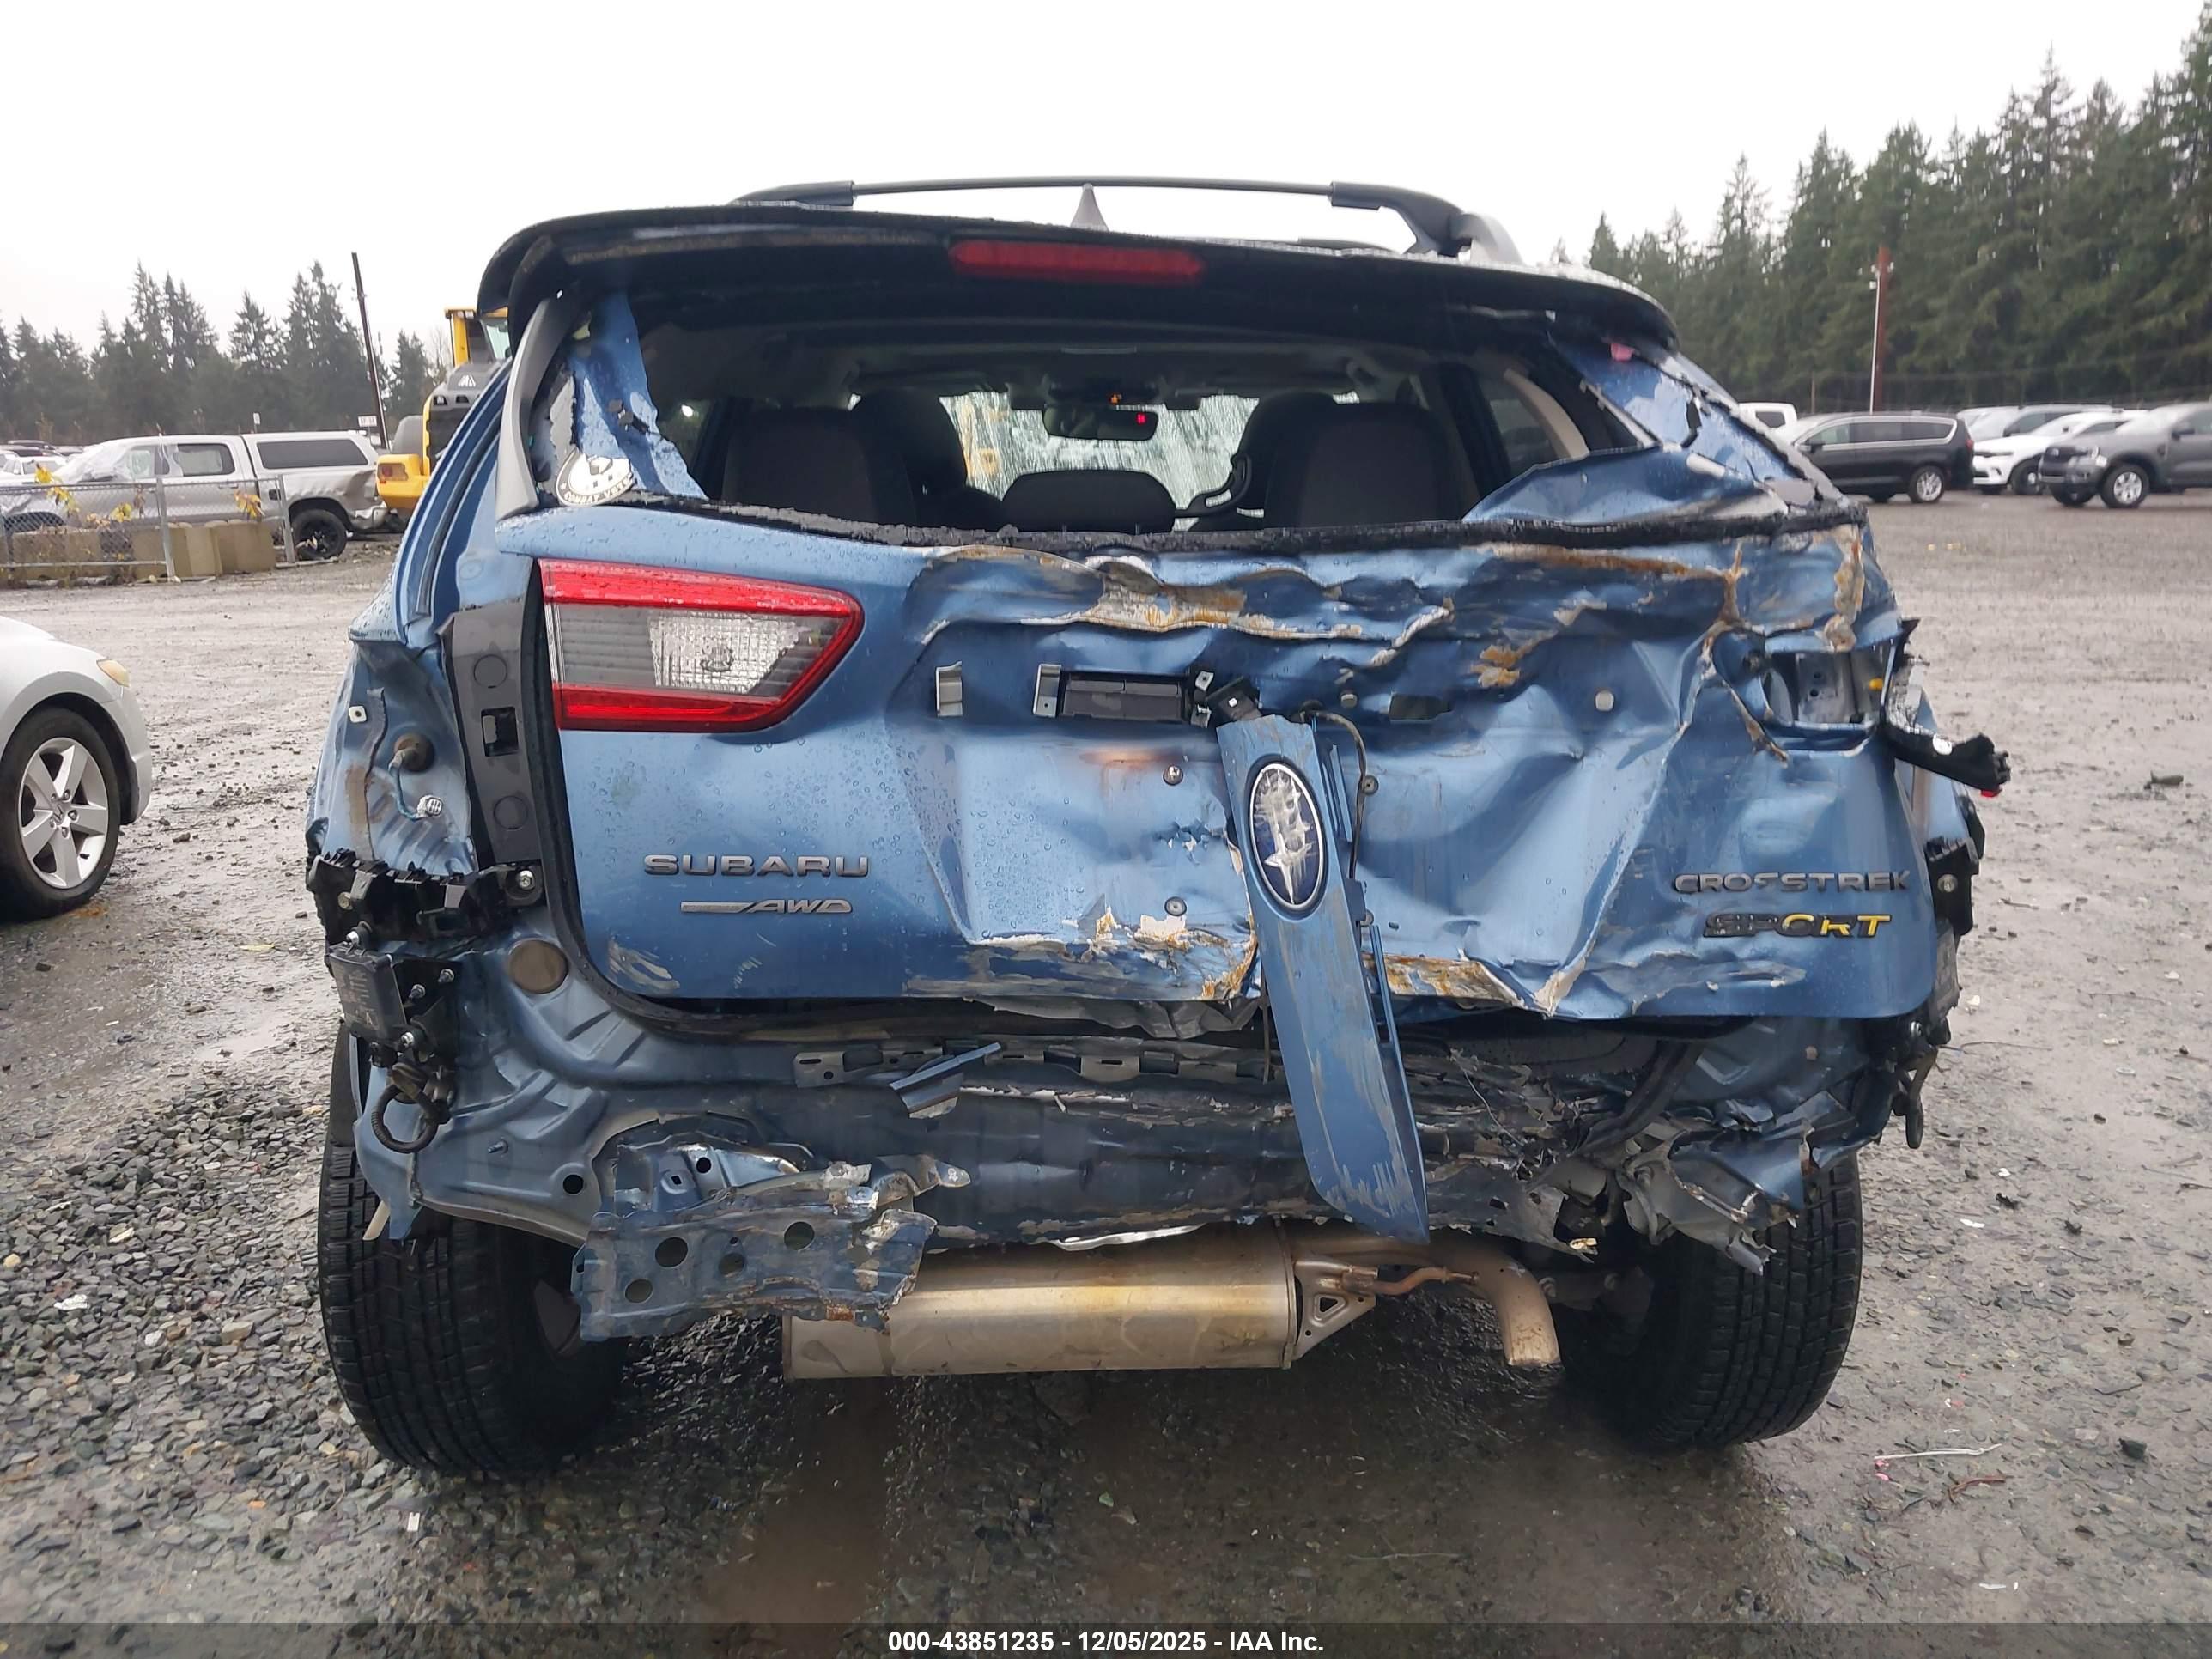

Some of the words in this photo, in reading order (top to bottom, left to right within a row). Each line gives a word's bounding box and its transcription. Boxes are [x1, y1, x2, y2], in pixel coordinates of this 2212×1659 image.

[643, 854, 869, 878] SUBARU
[1672, 870, 1911, 894] CROSSTREK
[744, 899, 853, 914] AWD
[1703, 913, 1892, 938] SPORT
